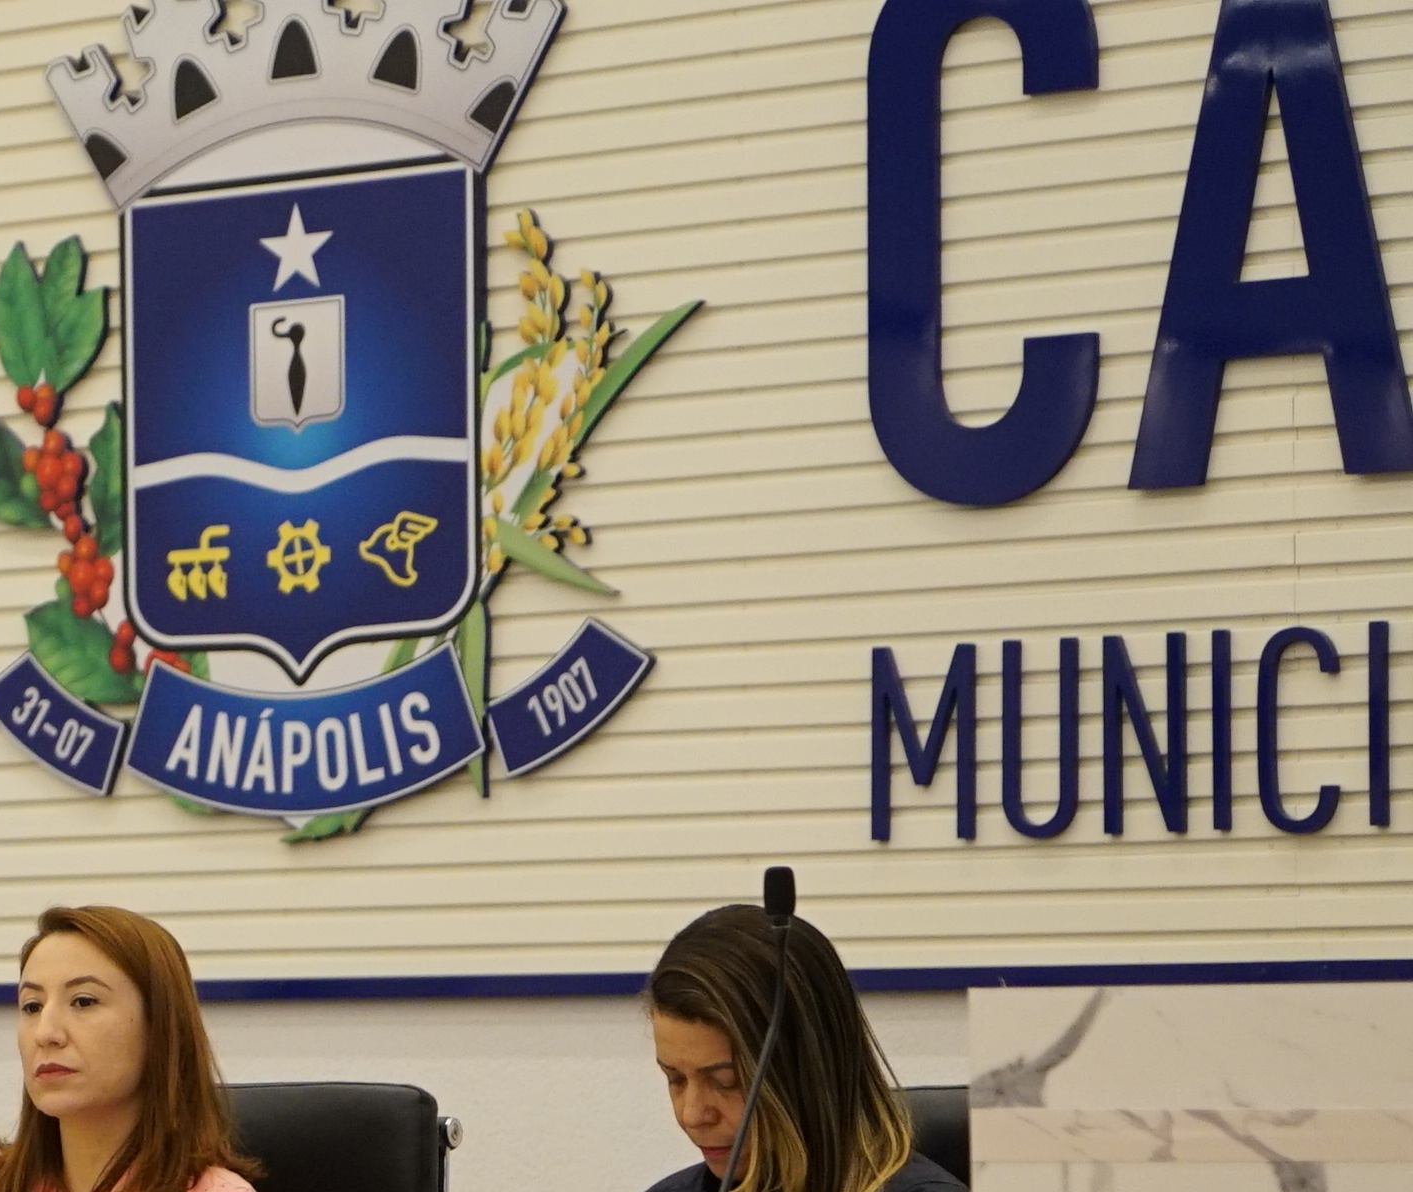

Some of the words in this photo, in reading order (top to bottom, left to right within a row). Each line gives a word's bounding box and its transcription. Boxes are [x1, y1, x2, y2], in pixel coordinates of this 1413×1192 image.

[868, 0, 1413, 508] CA
[11, 685, 95, 768] 31-07
[165, 691, 442, 794] ANÁPOLIS
[526, 656, 600, 738] 1907
[871, 621, 1390, 843] MUNICI
